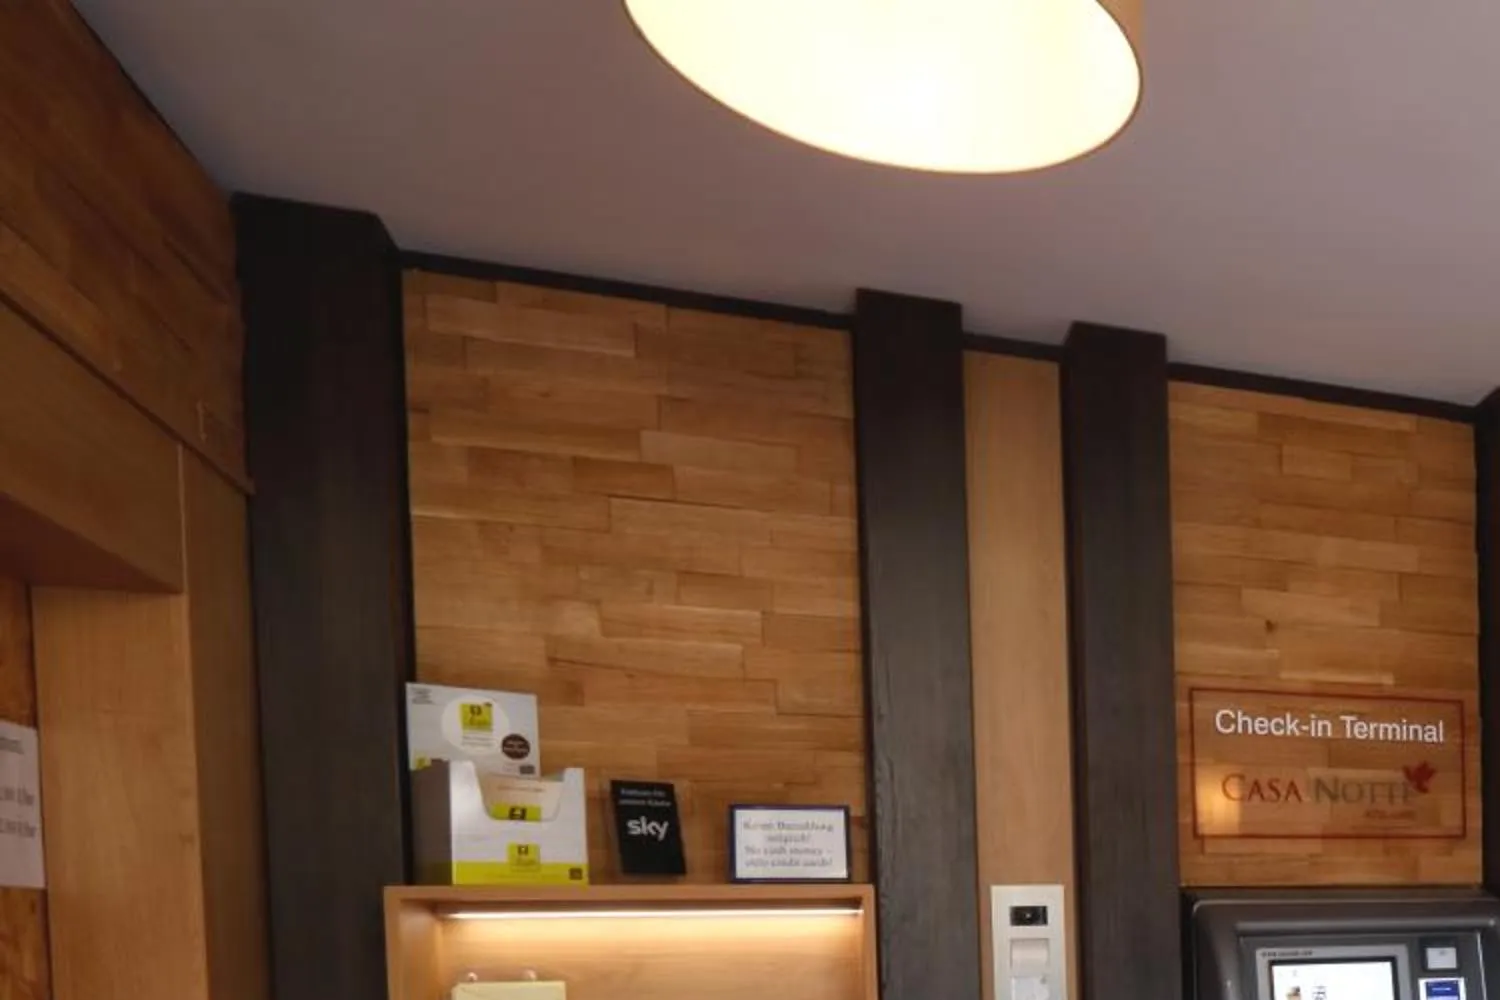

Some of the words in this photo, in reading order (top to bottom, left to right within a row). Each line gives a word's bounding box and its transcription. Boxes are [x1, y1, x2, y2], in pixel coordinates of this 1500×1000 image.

[1214, 708, 1332, 738] Check-in
[1340, 714, 1444, 743] Terminal
[1221, 772, 1303, 804] CASA
[626, 815, 669, 841] sky
